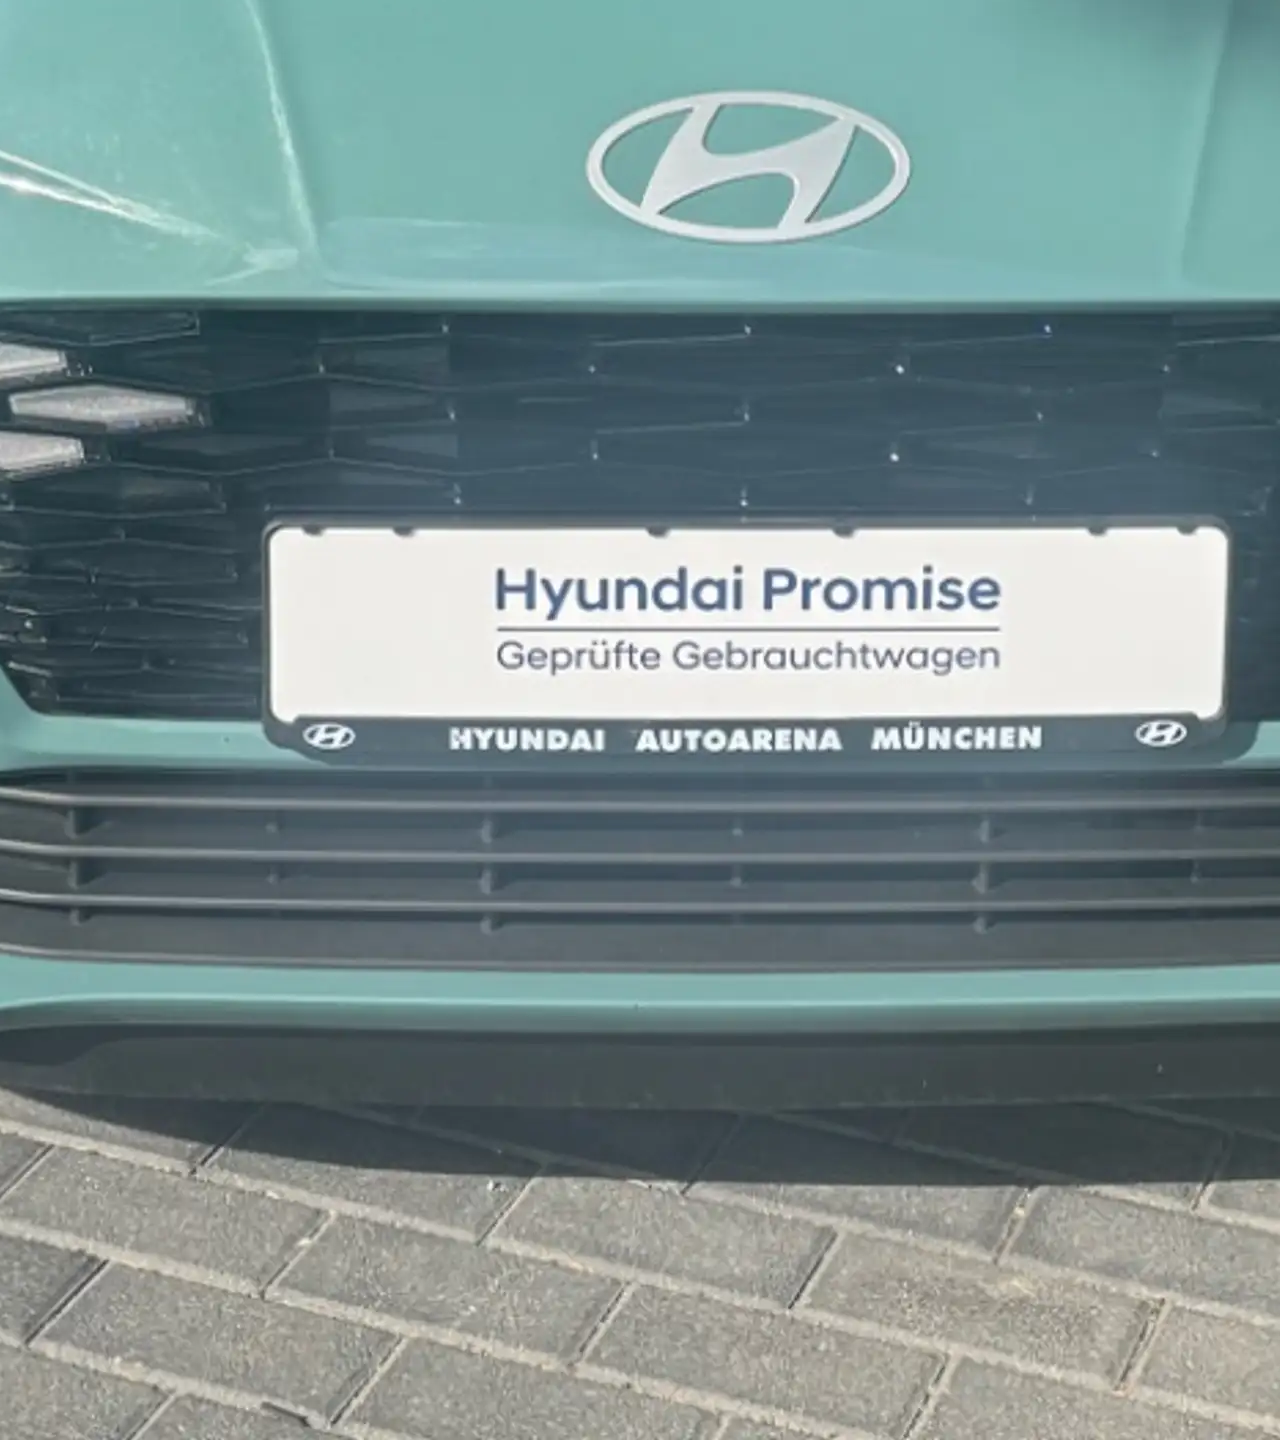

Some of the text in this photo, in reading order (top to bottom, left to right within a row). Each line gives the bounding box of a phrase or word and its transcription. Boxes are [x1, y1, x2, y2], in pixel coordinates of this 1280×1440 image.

[496, 565, 1001, 619] Hyundai Promise
[496, 639, 1001, 677] Geprüfte Gebrauchtwagen
[449, 720, 1042, 753] HYUNDAI AUTOARENA MÜNCHEN
